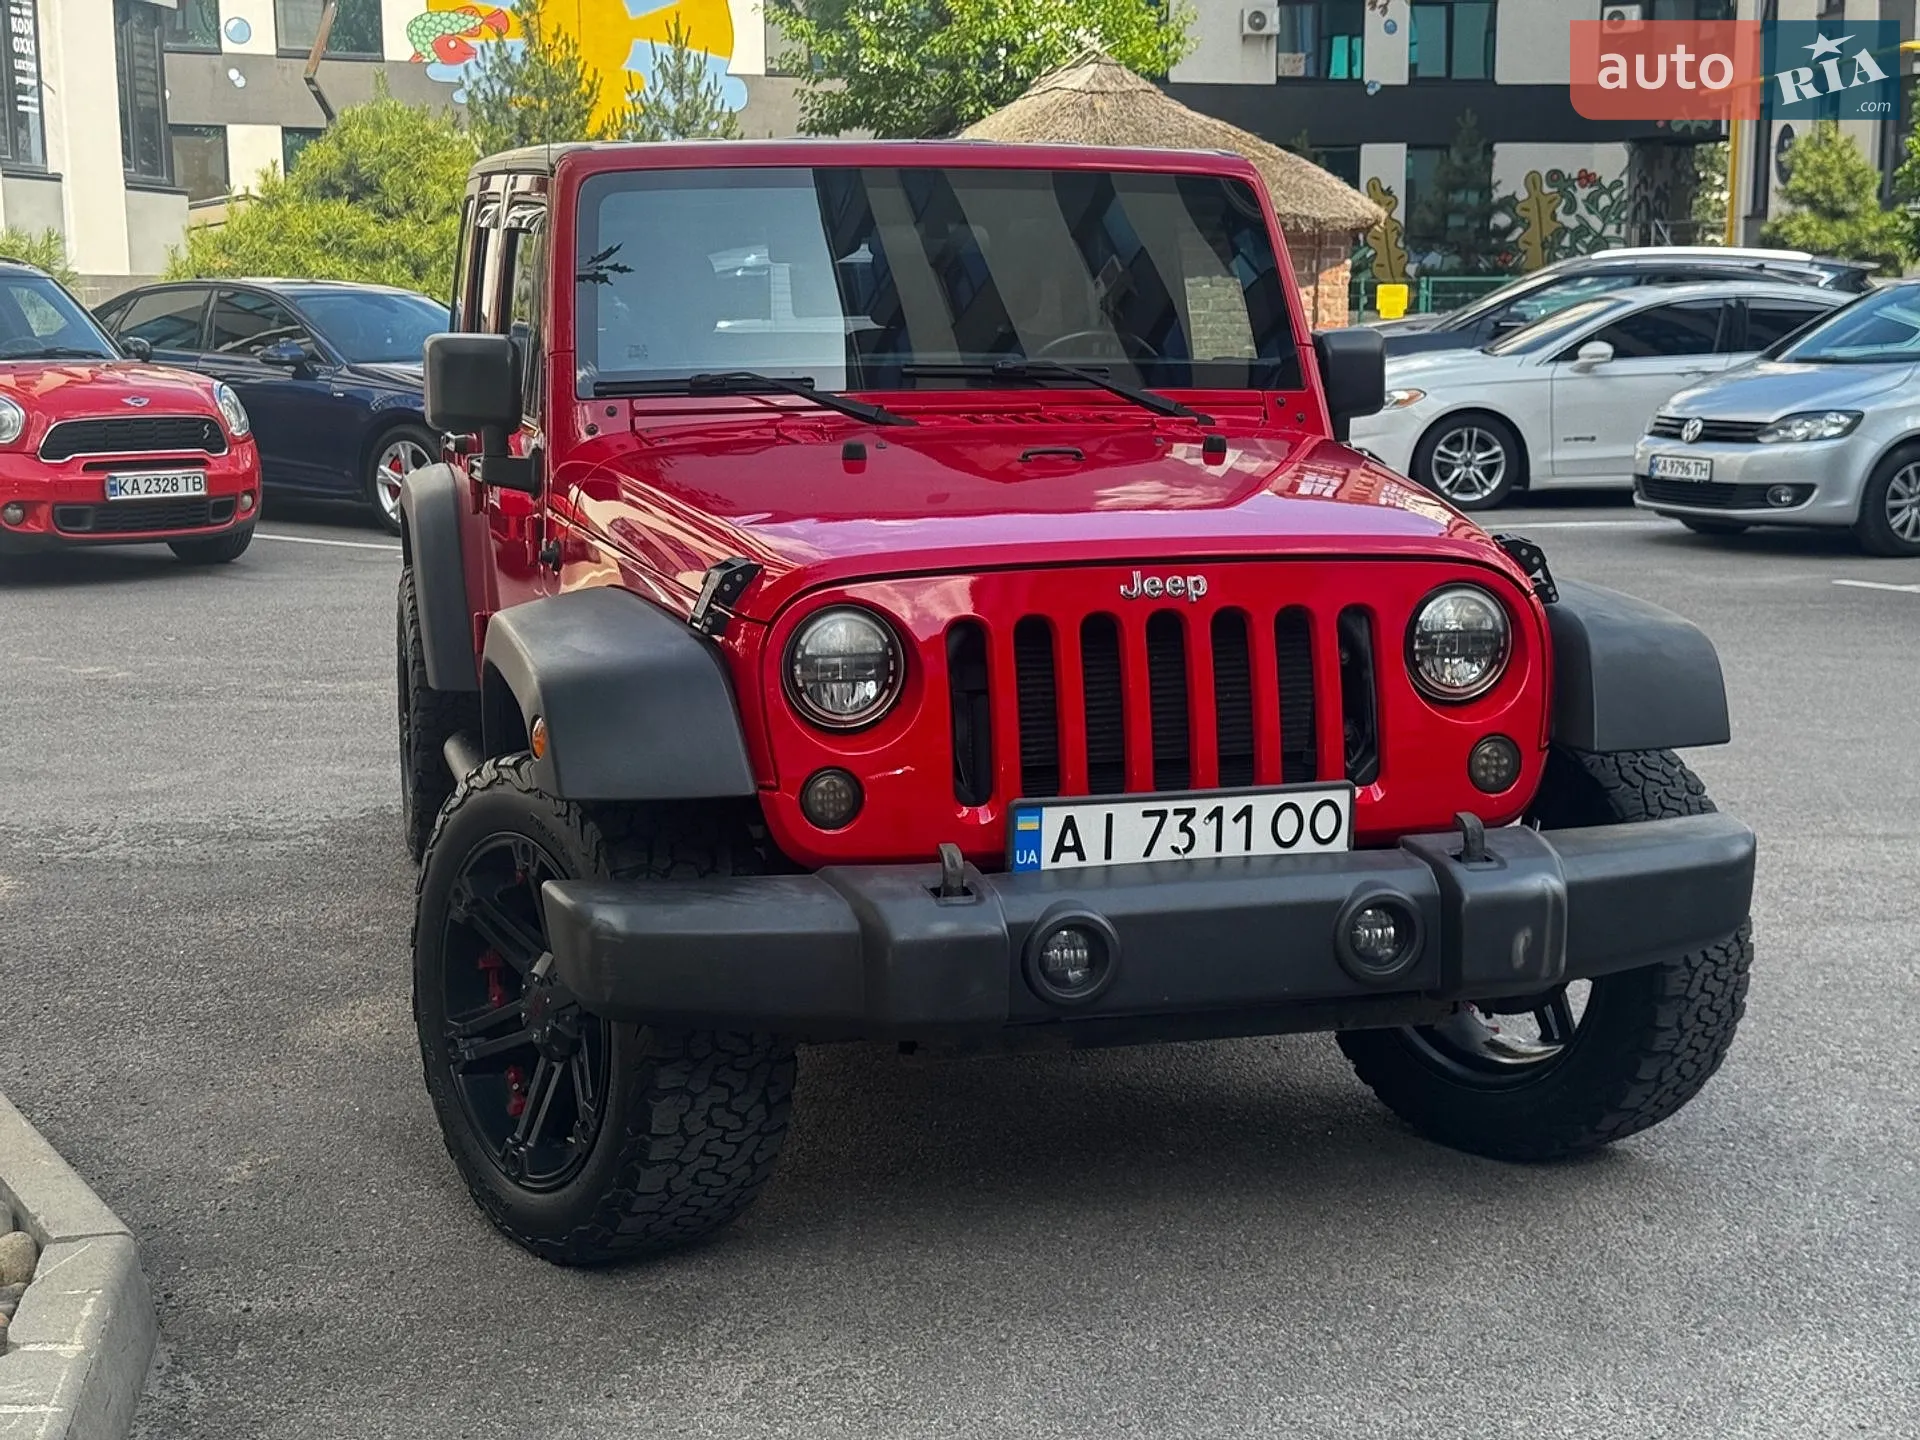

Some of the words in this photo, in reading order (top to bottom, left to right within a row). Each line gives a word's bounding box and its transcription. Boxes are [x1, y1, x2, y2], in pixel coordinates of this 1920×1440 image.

[118, 478, 141, 496] KA
[144, 477, 179, 494] 2328
[181, 475, 203, 492] TB
[1120, 570, 1208, 602] Jeep
[1051, 813, 1114, 863] AI
[1141, 804, 1253, 858] 7311
[1016, 849, 1039, 865] UA
